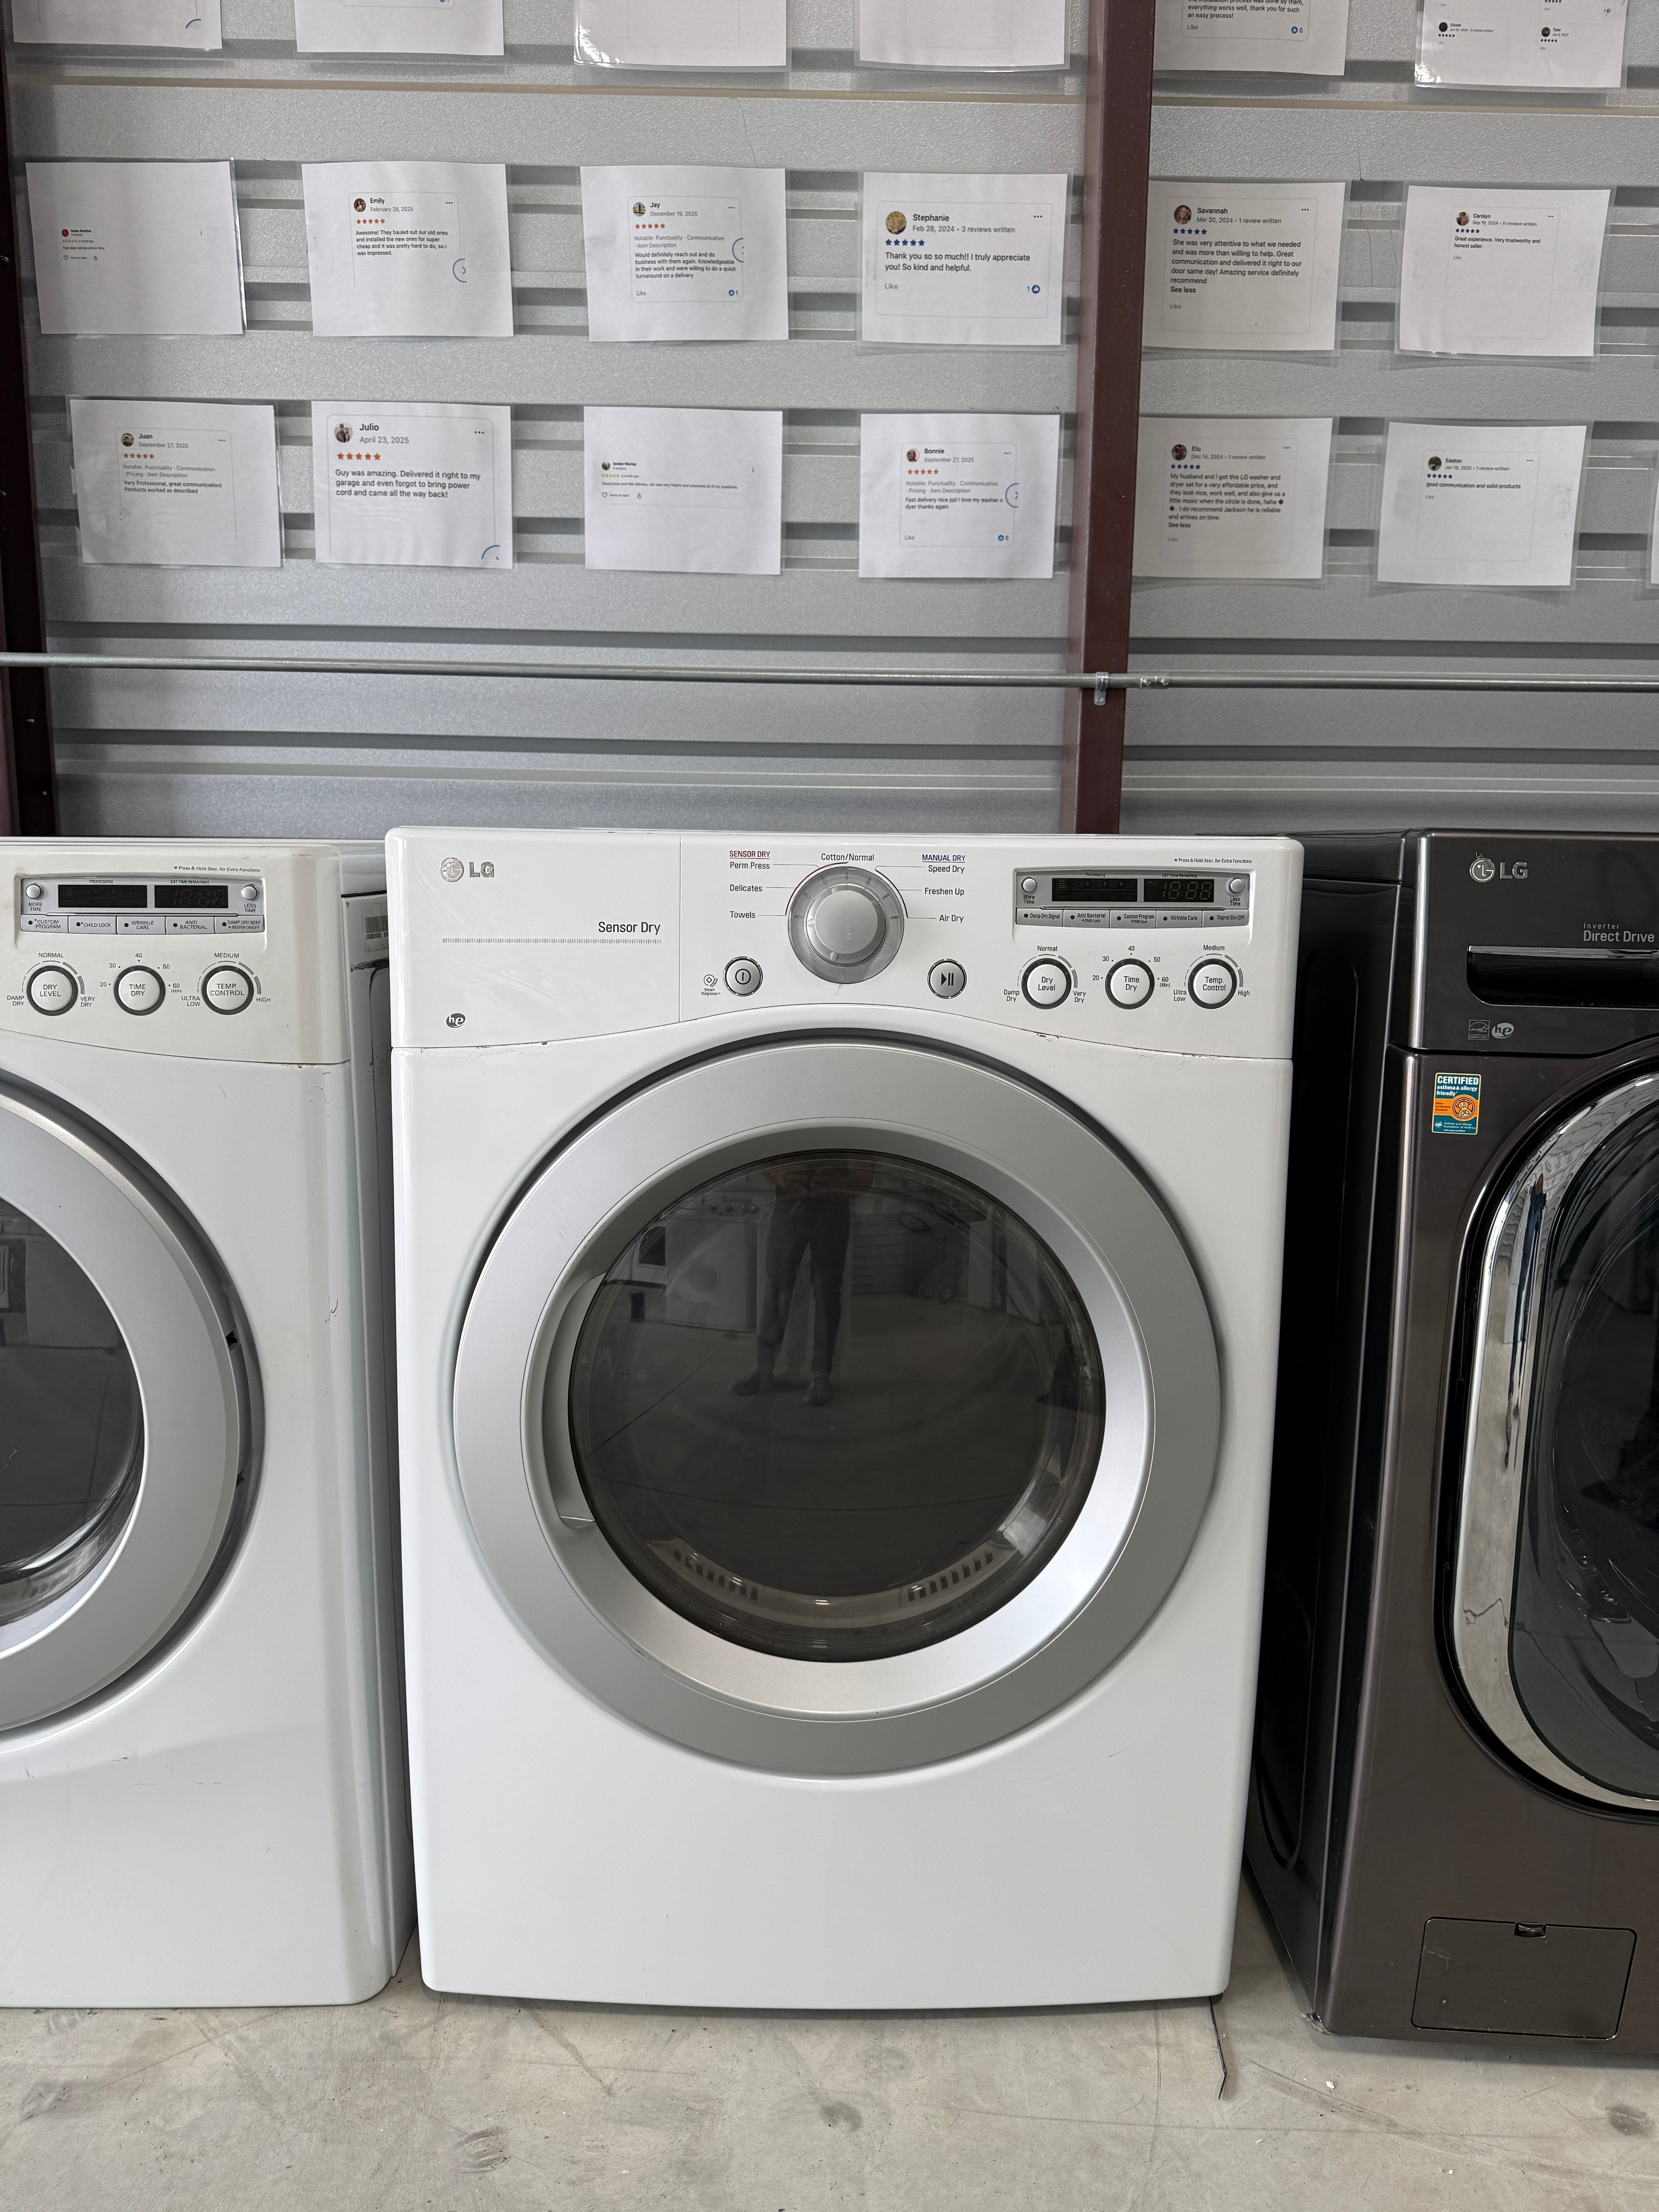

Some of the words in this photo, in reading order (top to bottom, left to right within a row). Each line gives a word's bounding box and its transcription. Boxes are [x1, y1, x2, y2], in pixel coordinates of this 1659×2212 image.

[913, 214, 949, 222] Stephanie
[975, 253, 991, 262] truly
[992, 254, 1030, 262] appreciate
[885, 263, 900, 271] you!
[945, 264, 971, 273] helpful.
[359, 436, 375, 444] April
[335, 469, 350, 477] Guy
[366, 470, 398, 478] amazing.
[442, 471, 459, 480] right
[821, 853, 874, 861] Cotton/Normal
[469, 861, 494, 877] LG
[928, 865, 950, 874] Speed
[952, 865, 964, 874] Dry
[1500, 862, 1528, 879] LG
[955, 888, 964, 896] Up
[951, 915, 963, 923] Dry
[598, 921, 638, 932] Sensor
[641, 922, 660, 935] Dry
[1583, 930, 1620, 942] Direct
[1623, 931, 1654, 942] Drive
[1203, 976, 1226, 985] Temp.
[1125, 984, 1137, 992] Dry
[1437, 1076, 1479, 1085] CERTIFIED
